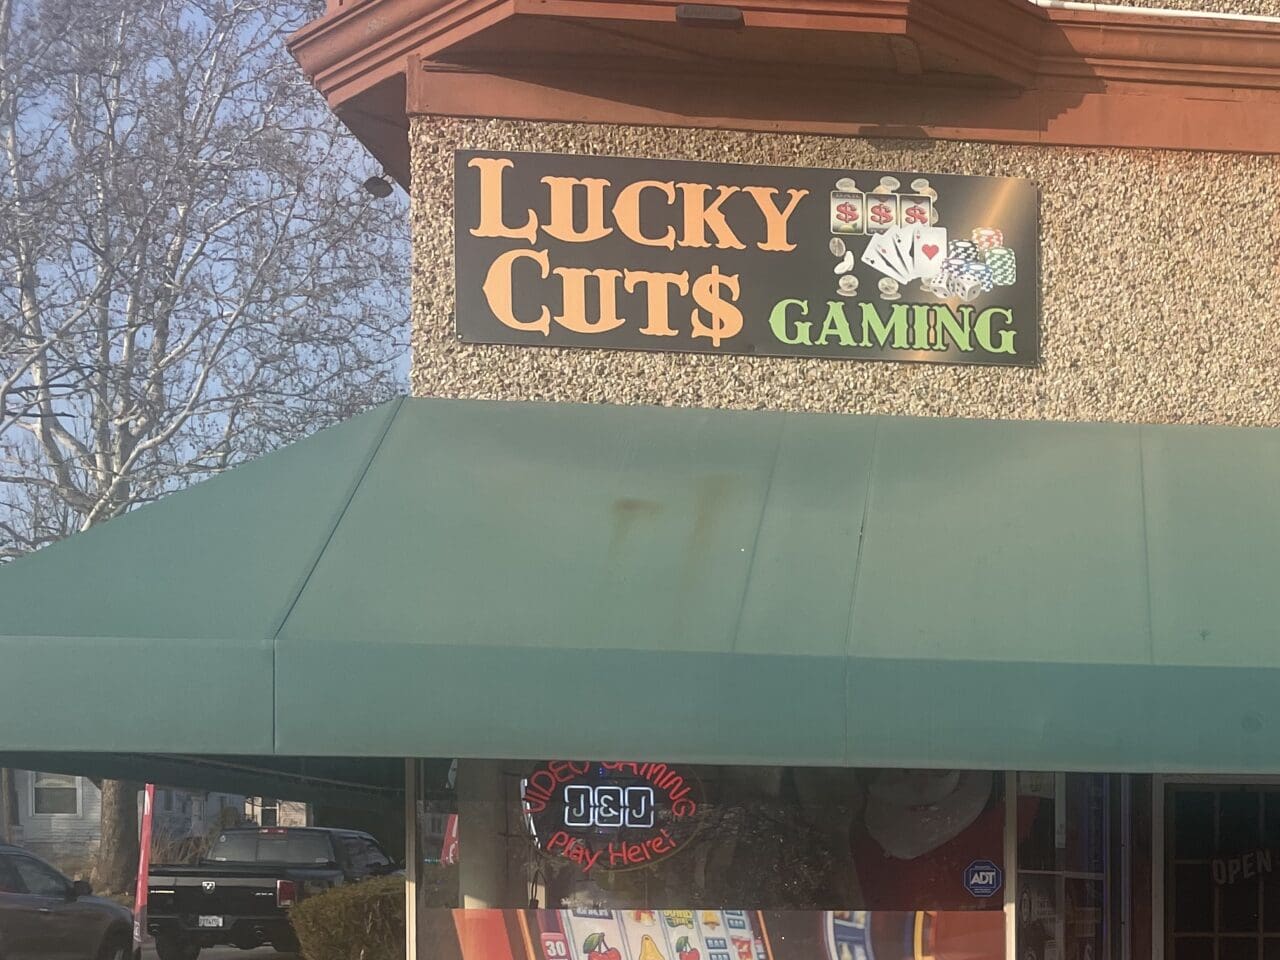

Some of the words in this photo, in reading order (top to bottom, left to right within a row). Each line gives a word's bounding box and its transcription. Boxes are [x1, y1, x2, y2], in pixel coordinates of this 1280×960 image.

[467, 157, 810, 253] LUCKY
[482, 249, 744, 347] CUT$
[768, 298, 1018, 355] GAMING
[547, 831, 603, 873] Play
[1211, 850, 1272, 886] OPEN
[971, 871, 996, 885] ADT
[545, 940, 566, 957] 30
